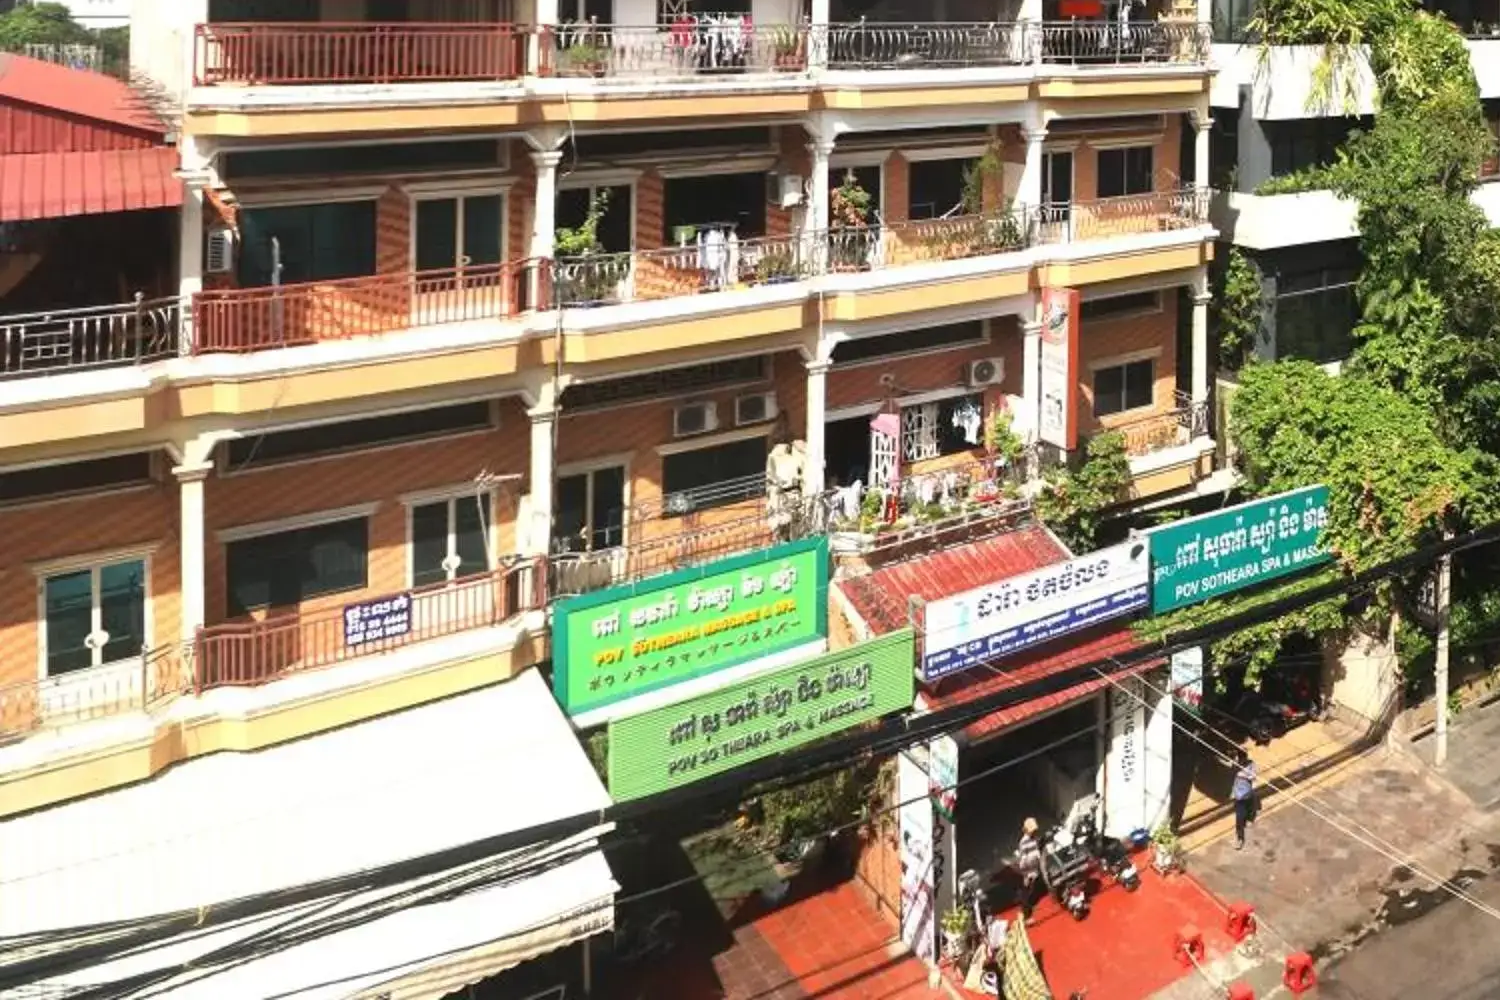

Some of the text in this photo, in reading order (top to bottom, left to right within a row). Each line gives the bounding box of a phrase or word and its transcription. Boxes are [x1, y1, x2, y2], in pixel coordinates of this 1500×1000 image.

[1175, 580, 1200, 601] POV
[1201, 562, 1260, 592] SOTHEARA
[1261, 556, 1282, 574] SPA
[1283, 551, 1292, 567] &
[593, 648, 626, 668] POV
[668, 752, 698, 775] POV
[776, 719, 801, 740] SPA
[803, 715, 816, 731] &
[819, 694, 875, 724] MASSAGE
